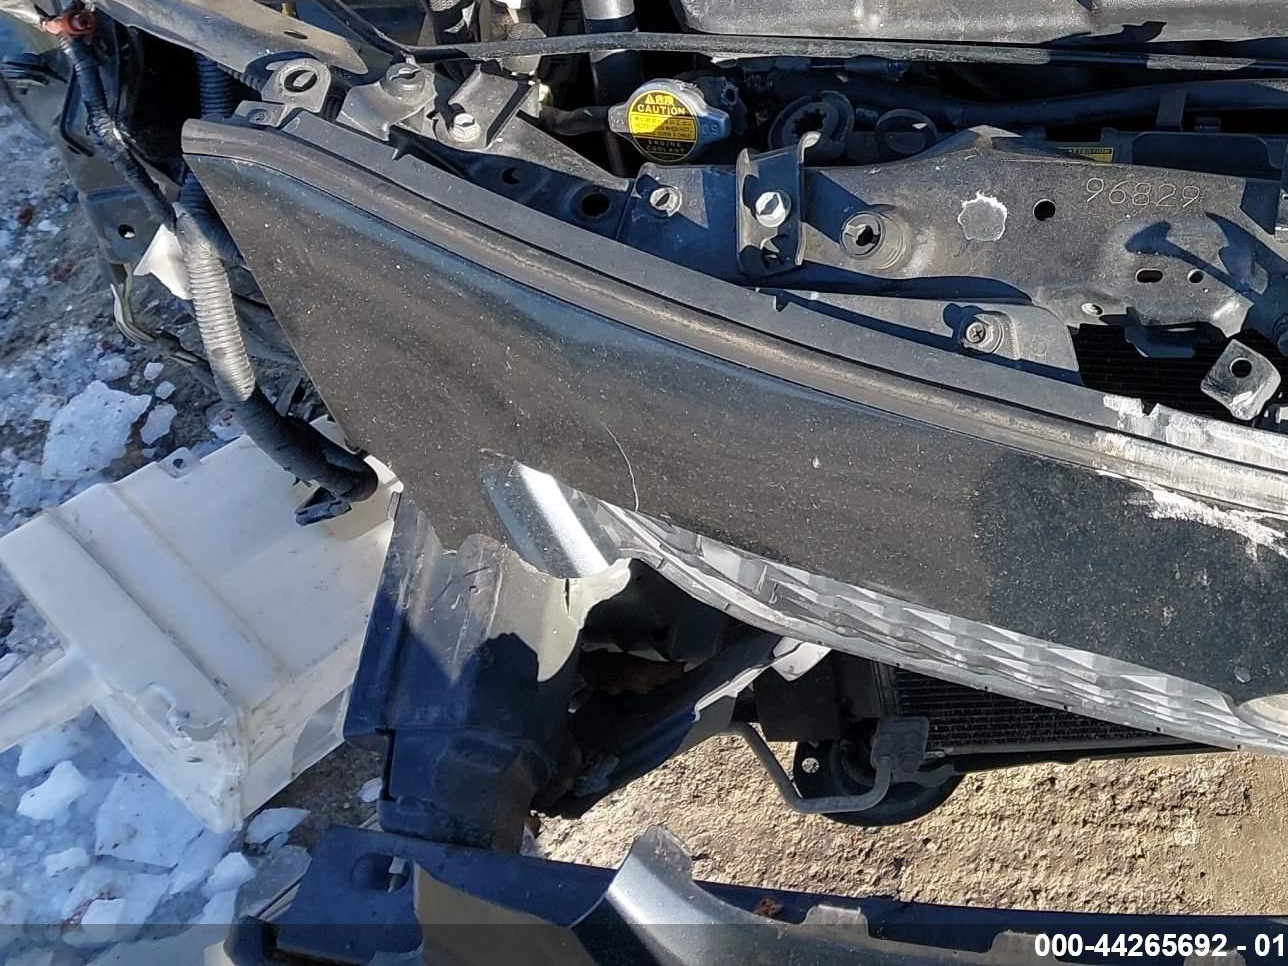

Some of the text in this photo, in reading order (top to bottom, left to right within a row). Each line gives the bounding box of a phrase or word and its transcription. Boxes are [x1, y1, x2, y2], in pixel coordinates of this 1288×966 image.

[637, 104, 686, 116] CAUTION
[647, 139, 682, 148] ENGINE
[645, 145, 686, 154] COOLANT
[1085, 176, 1201, 209] 96829
